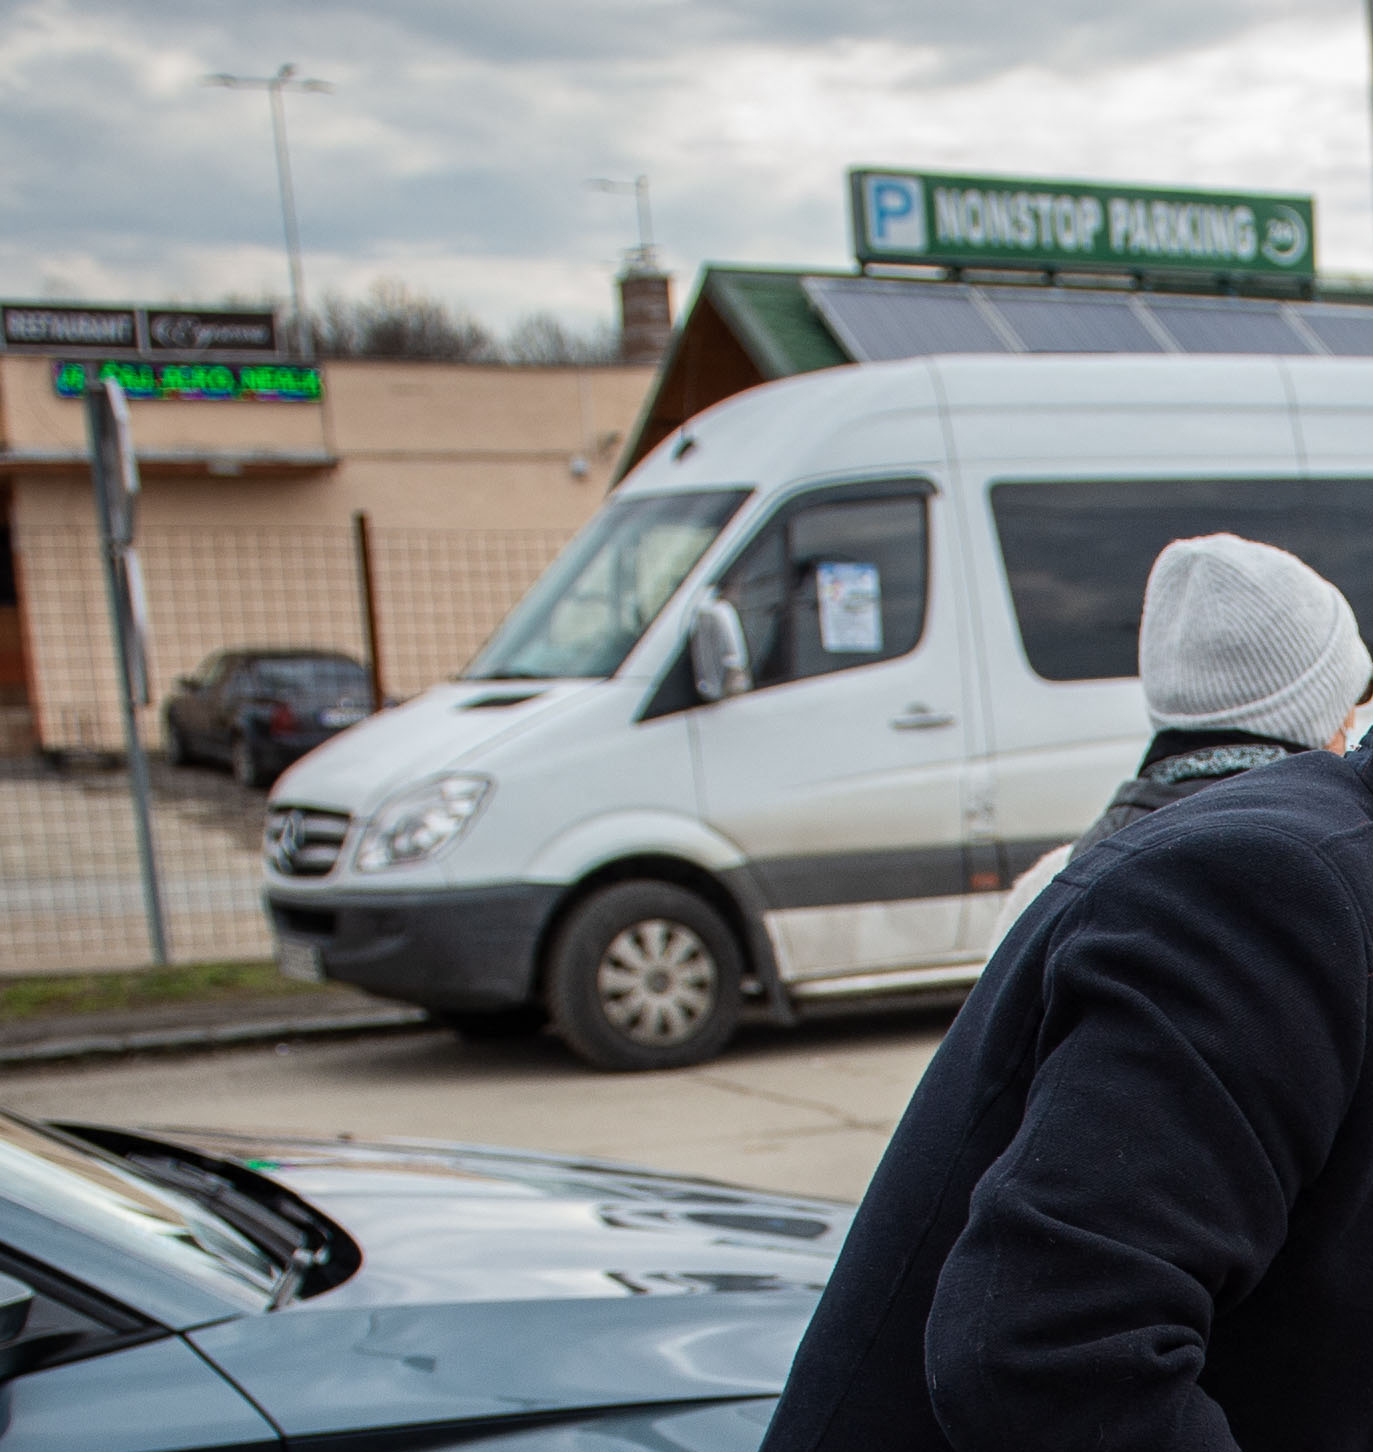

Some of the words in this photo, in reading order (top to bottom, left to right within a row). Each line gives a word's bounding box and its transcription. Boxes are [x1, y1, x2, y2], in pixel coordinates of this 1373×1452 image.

[872, 180, 912, 238] P
[934, 186, 1100, 254] NONSTOP
[1108, 201, 1258, 262] PARKING
